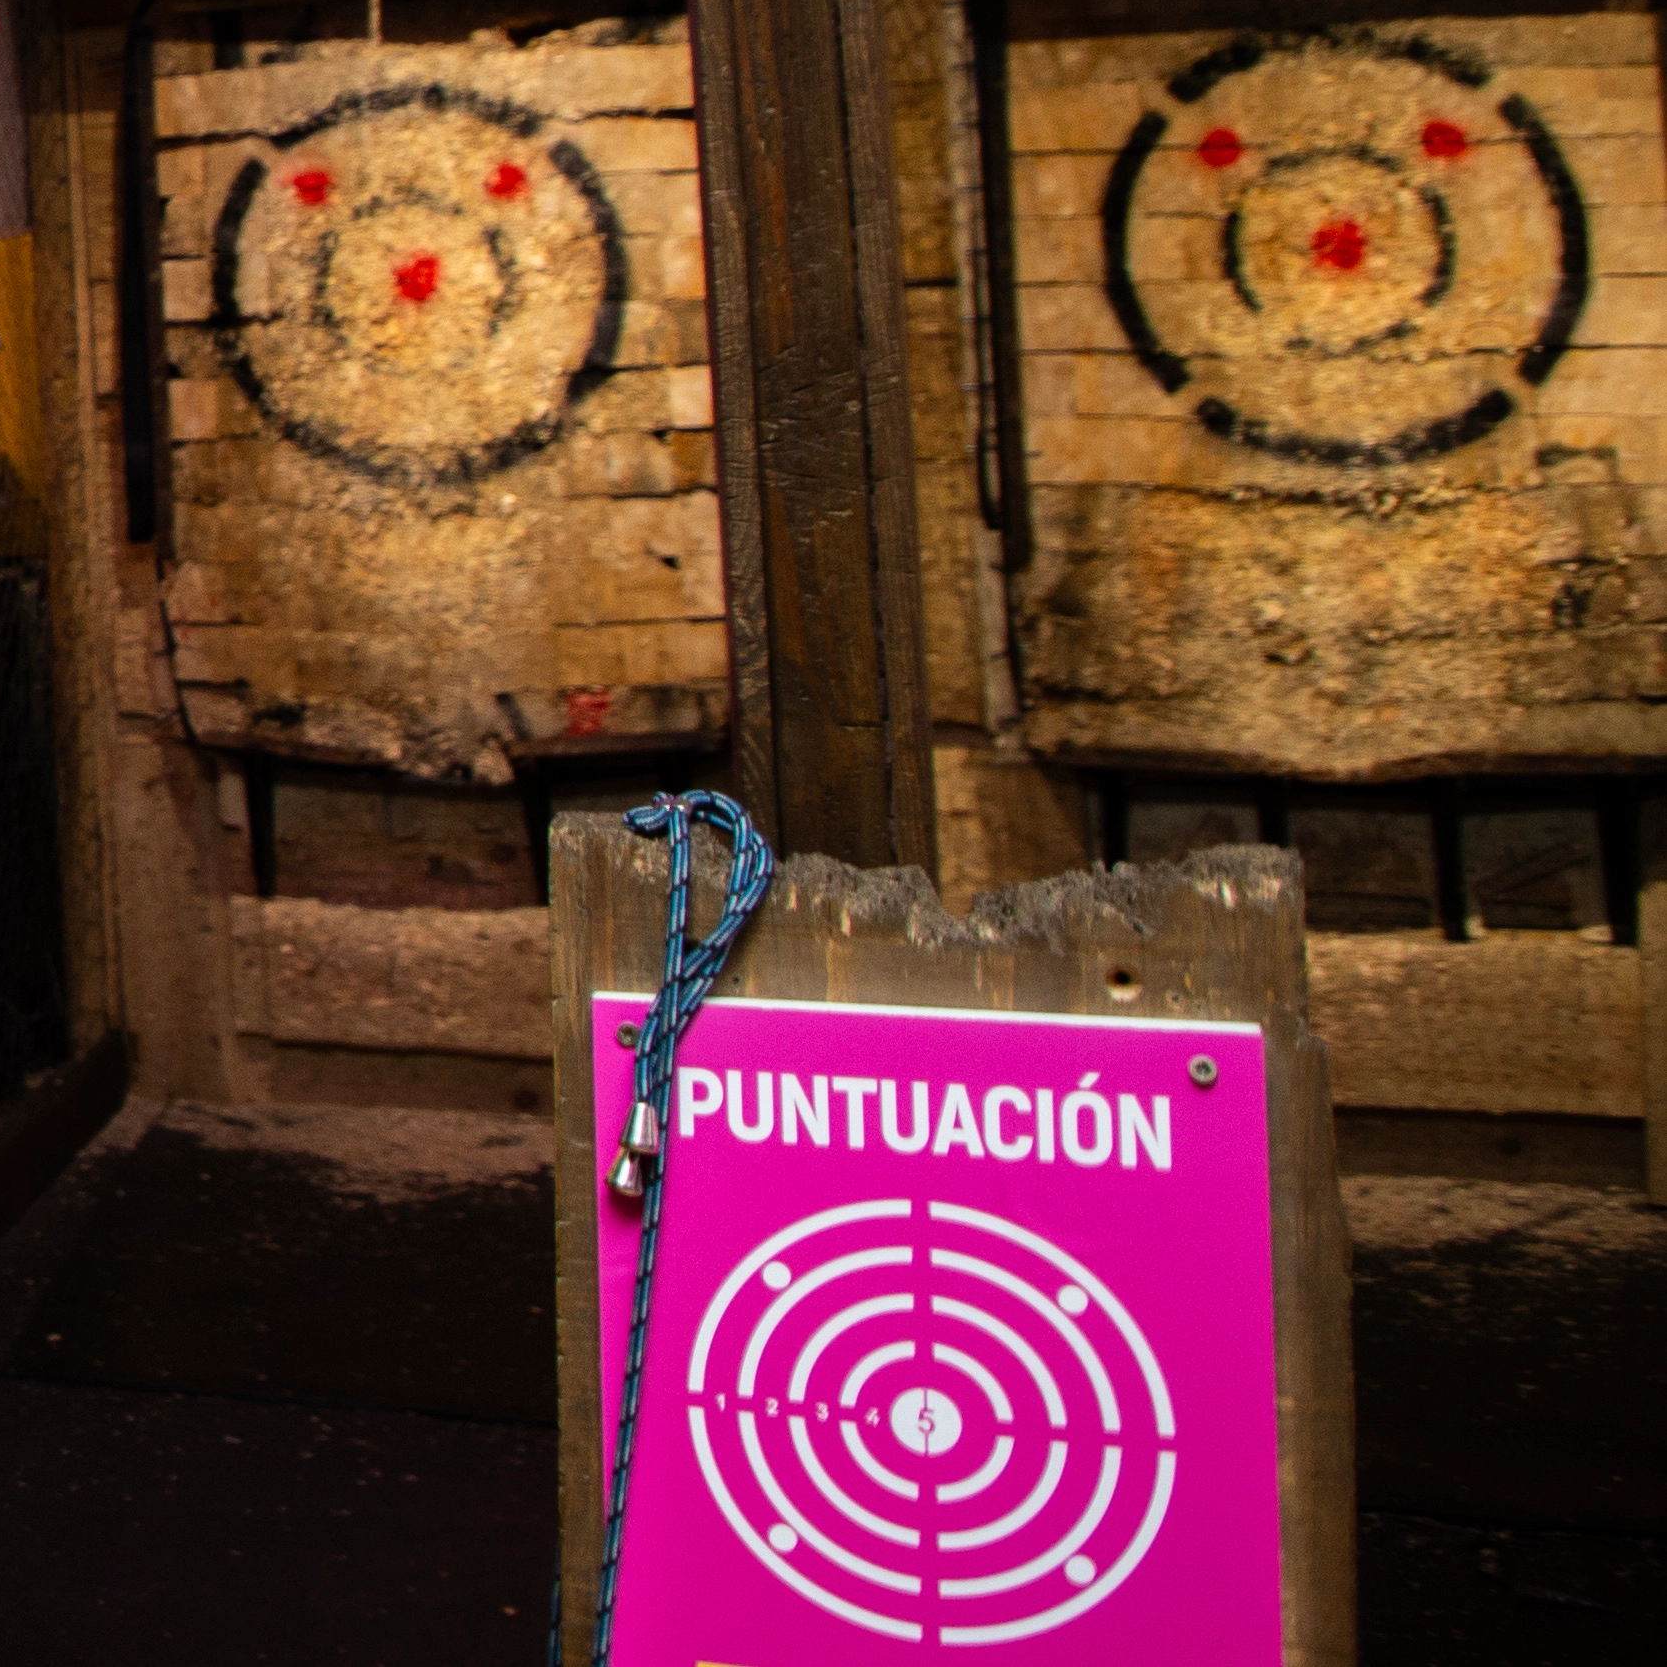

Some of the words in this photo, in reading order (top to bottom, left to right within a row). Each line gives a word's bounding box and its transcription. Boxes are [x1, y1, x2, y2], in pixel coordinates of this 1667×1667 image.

[677, 1066, 1173, 1171] PUNTUACIÓN
[716, 1392, 726, 1413] 1
[767, 1397, 780, 1418] 2
[815, 1402, 829, 1423] 3
[865, 1407, 880, 1428] 4
[917, 1408, 937, 1435] 5
